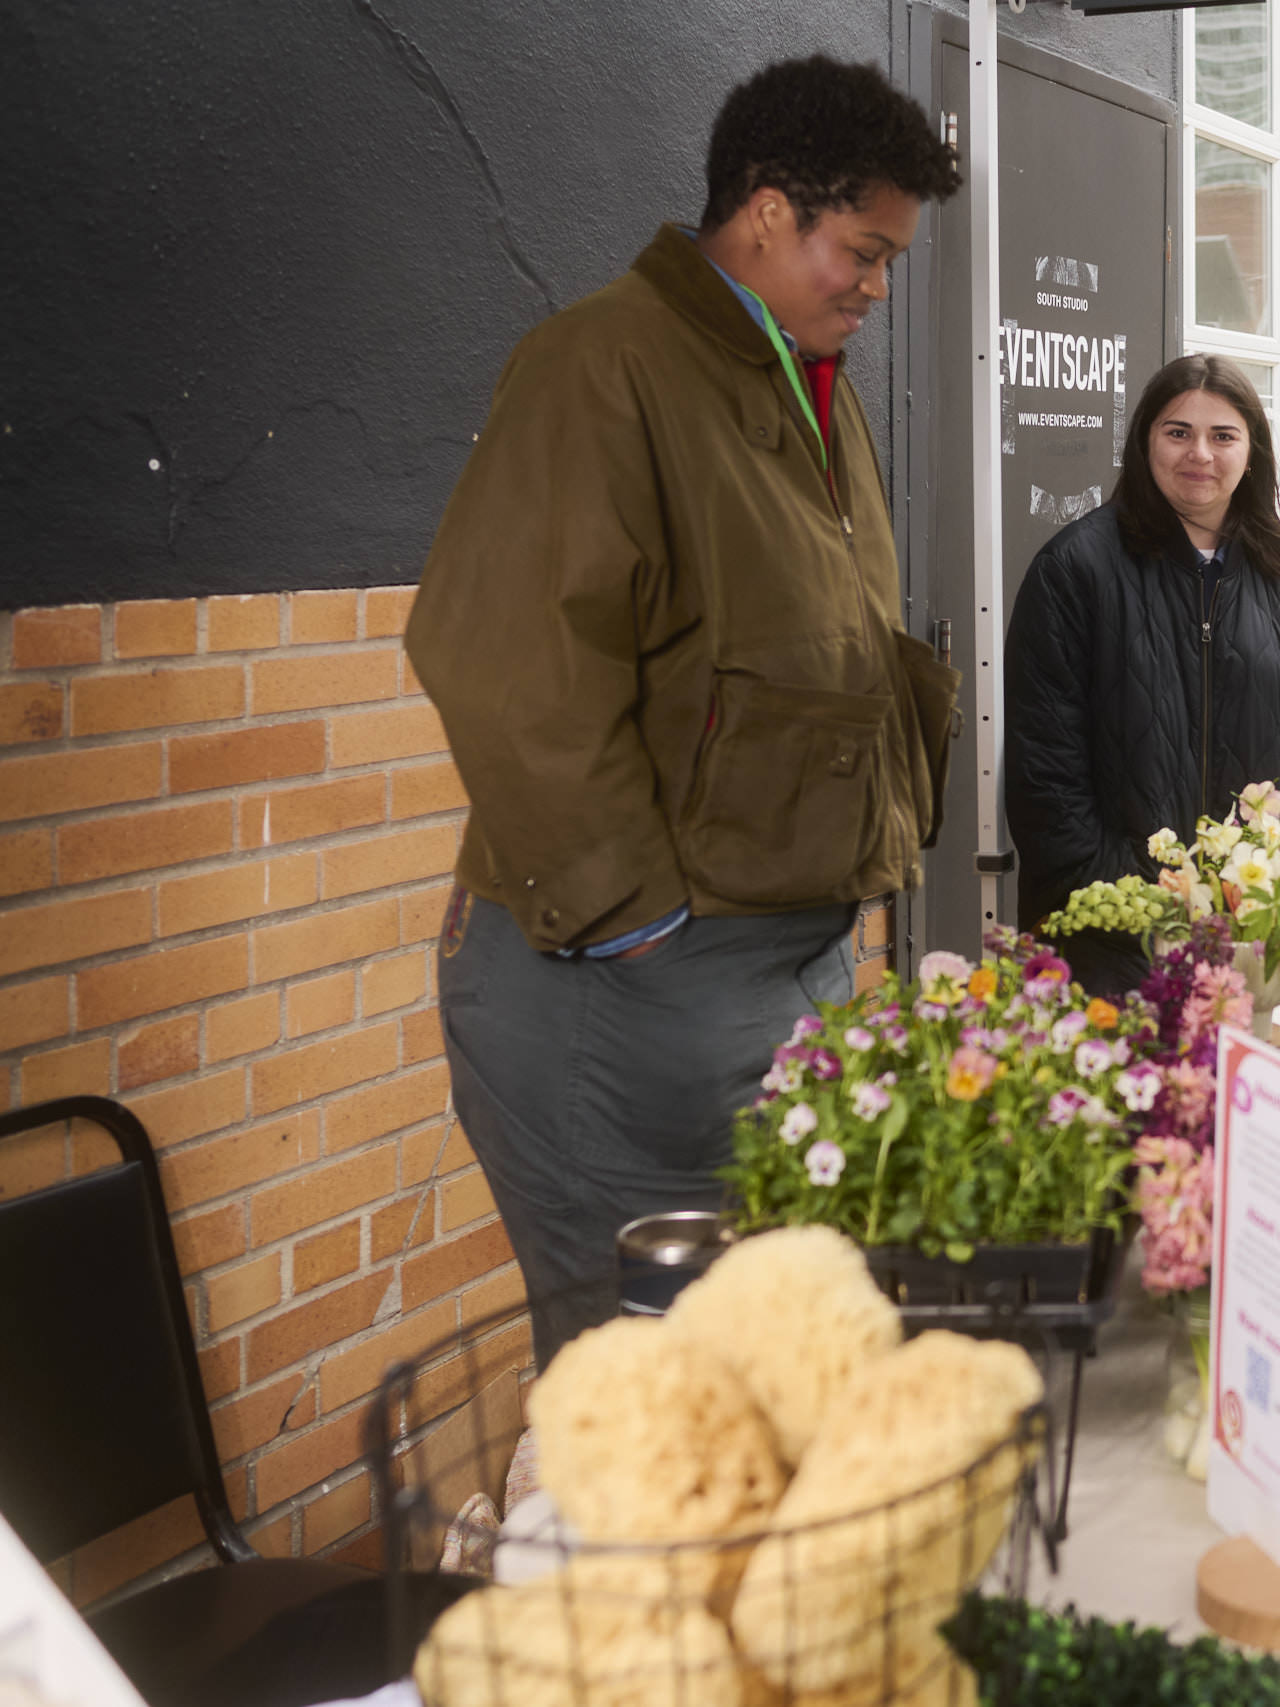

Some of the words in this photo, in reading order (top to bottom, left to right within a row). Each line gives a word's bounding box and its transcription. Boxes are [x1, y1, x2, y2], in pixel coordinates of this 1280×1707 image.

[1037, 293, 1061, 308] SOUTH
[1063, 296, 1088, 311] STUDIO
[1018, 412, 1103, 429] WWW.EVENTSCAPE.COM
